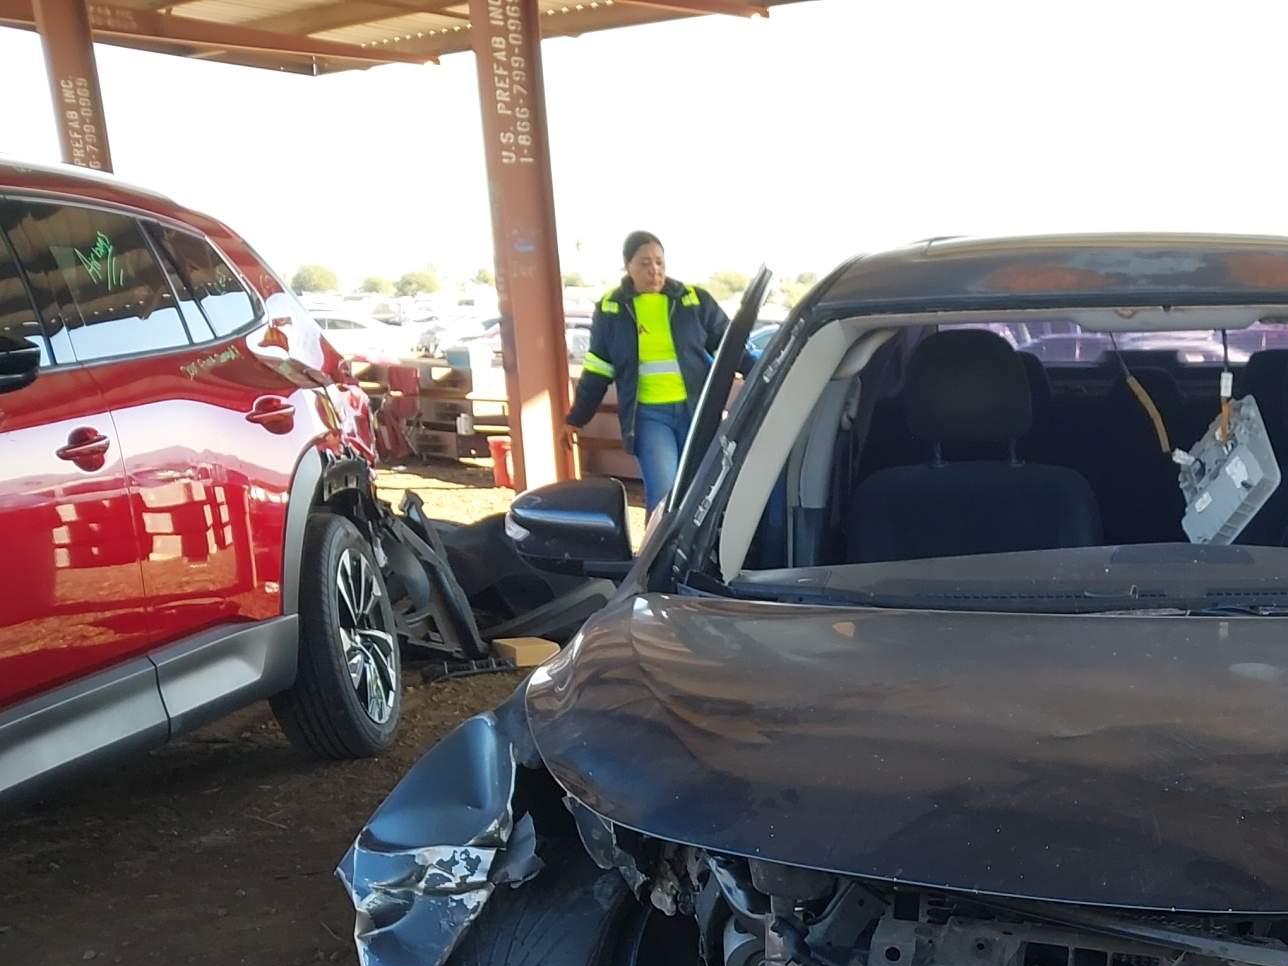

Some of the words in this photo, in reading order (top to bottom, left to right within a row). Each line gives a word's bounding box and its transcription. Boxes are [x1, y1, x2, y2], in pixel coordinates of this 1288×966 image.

[490, 36, 513, 115] PREFAB
[505, 0, 535, 163] 1-866-799-096
[66, 110, 87, 166] PREFAB
[500, 126, 517, 164] U.S.
